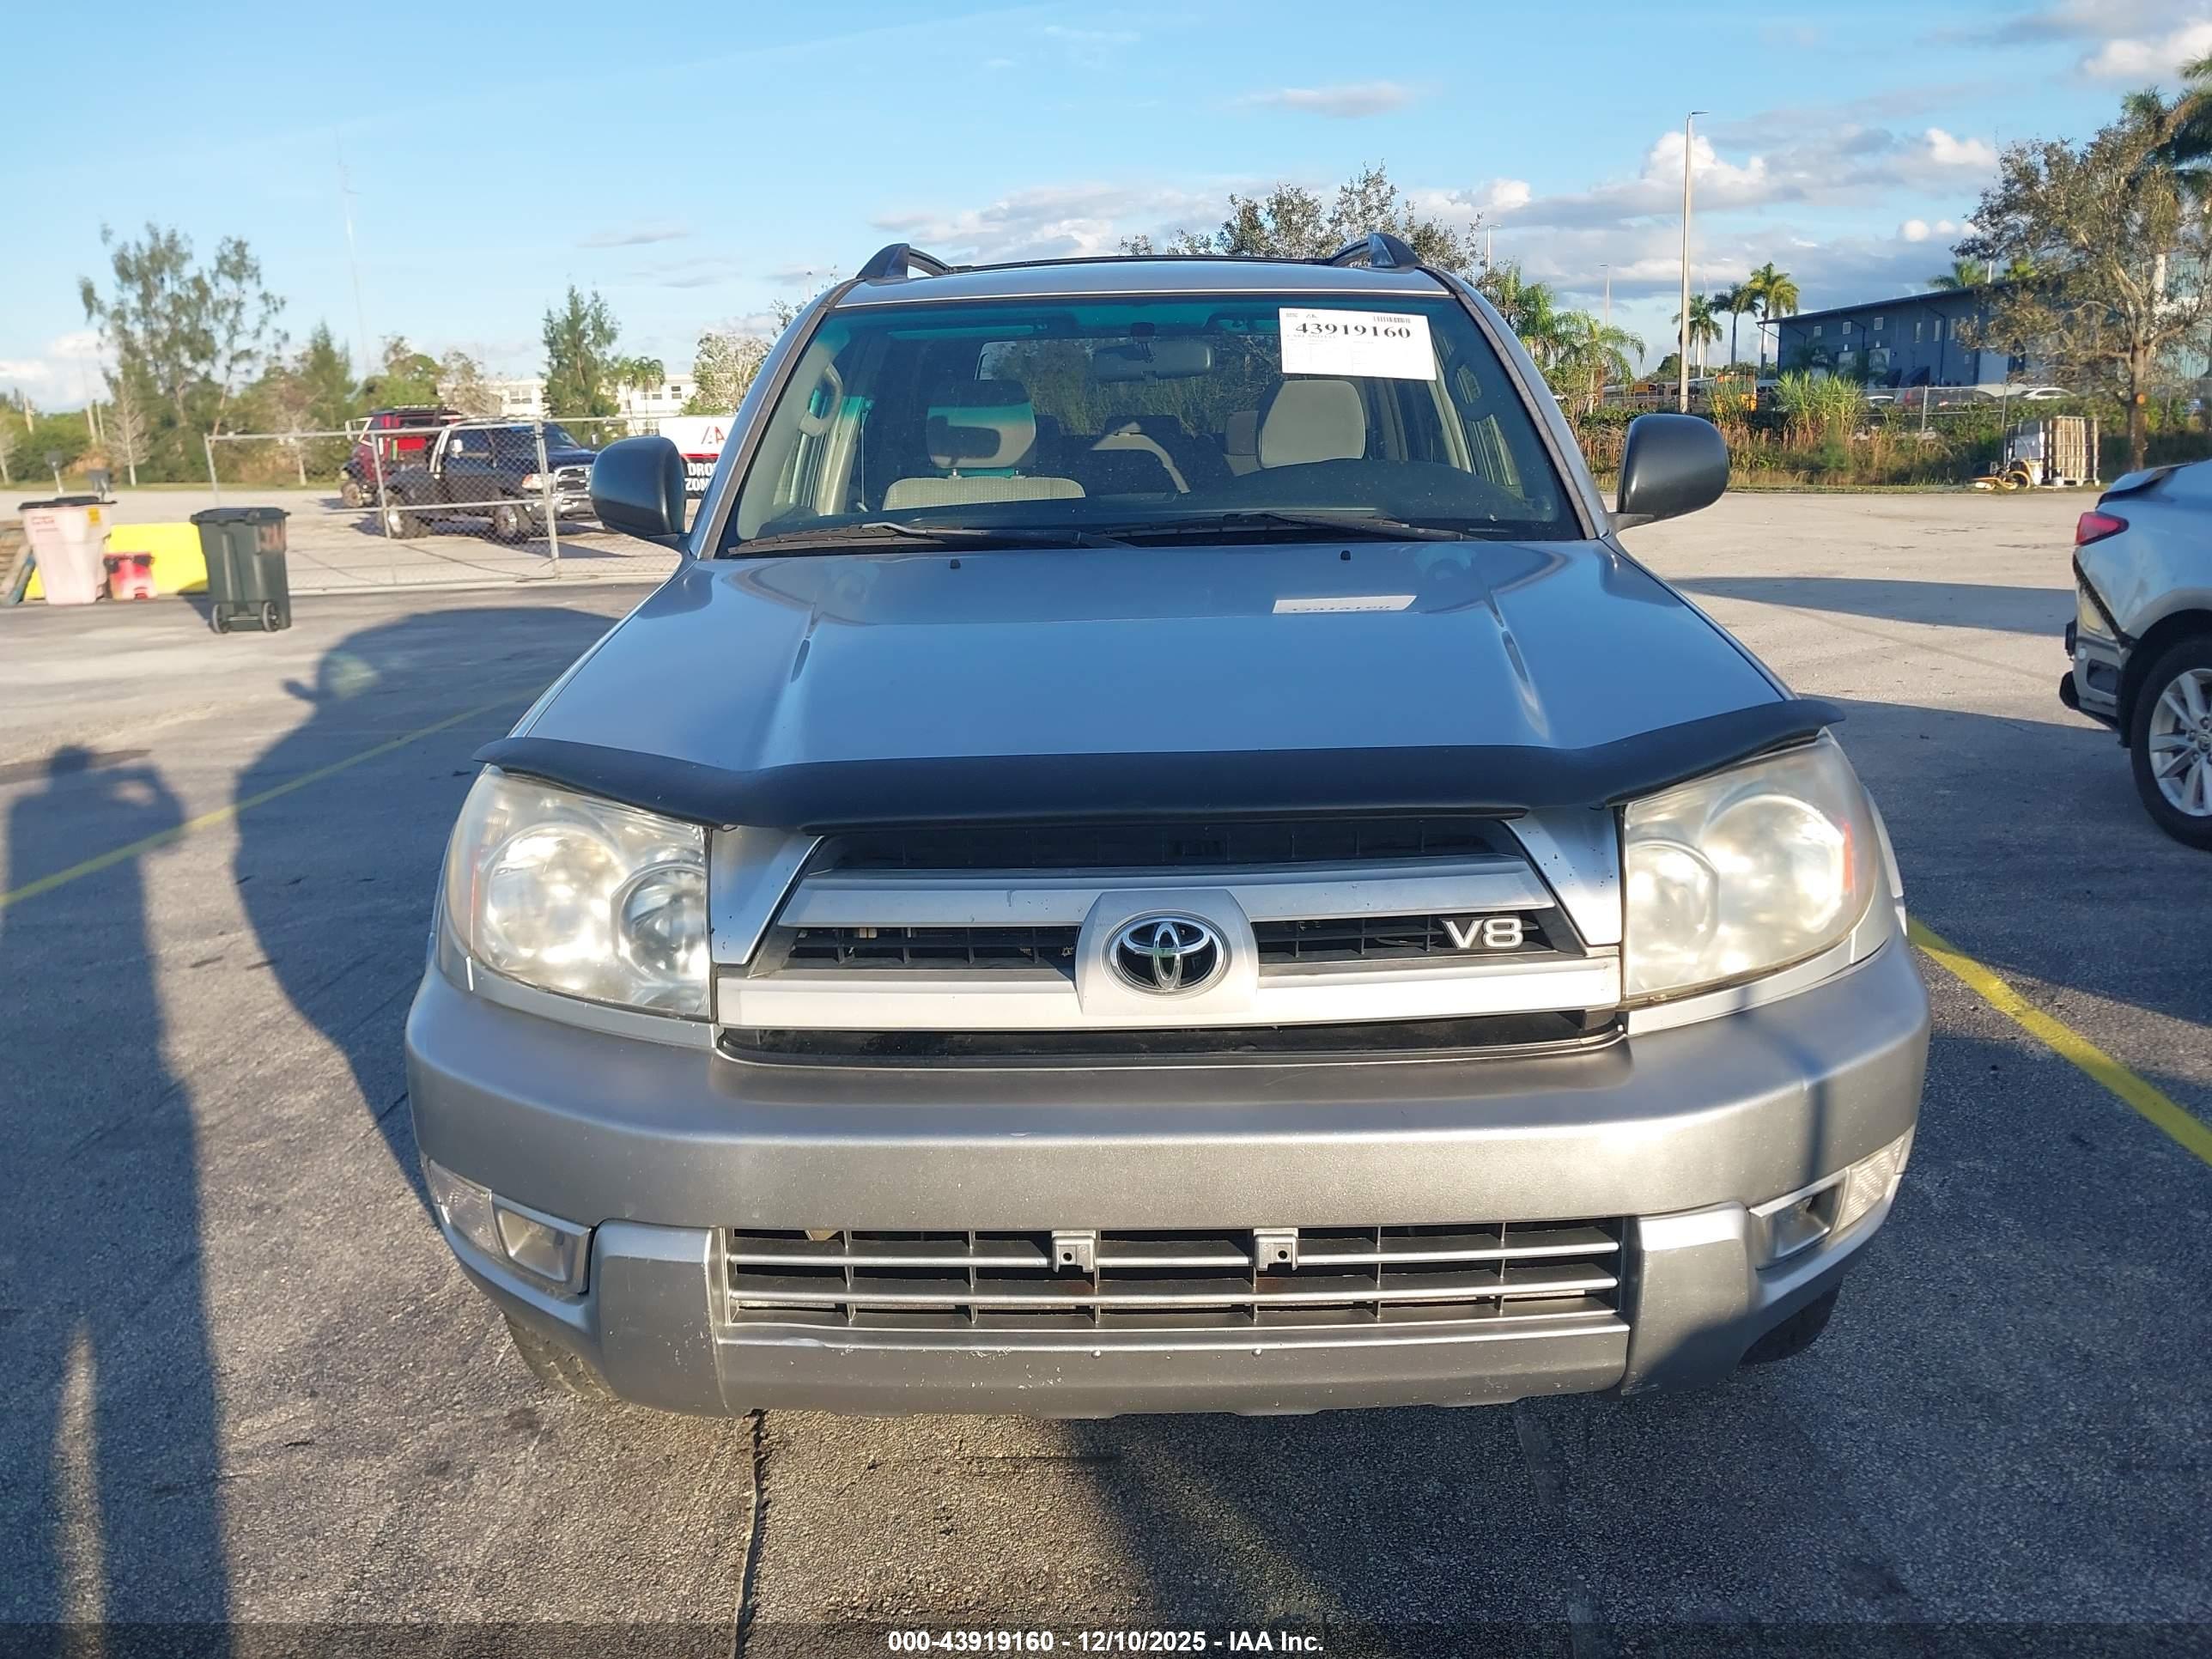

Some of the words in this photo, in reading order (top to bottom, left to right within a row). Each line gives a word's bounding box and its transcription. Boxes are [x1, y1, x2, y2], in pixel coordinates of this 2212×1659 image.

[1295, 322, 1411, 339] 43919160
[687, 462, 714, 477] DRO
[684, 477, 710, 492] ZON
[1439, 916, 1524, 950] V8
